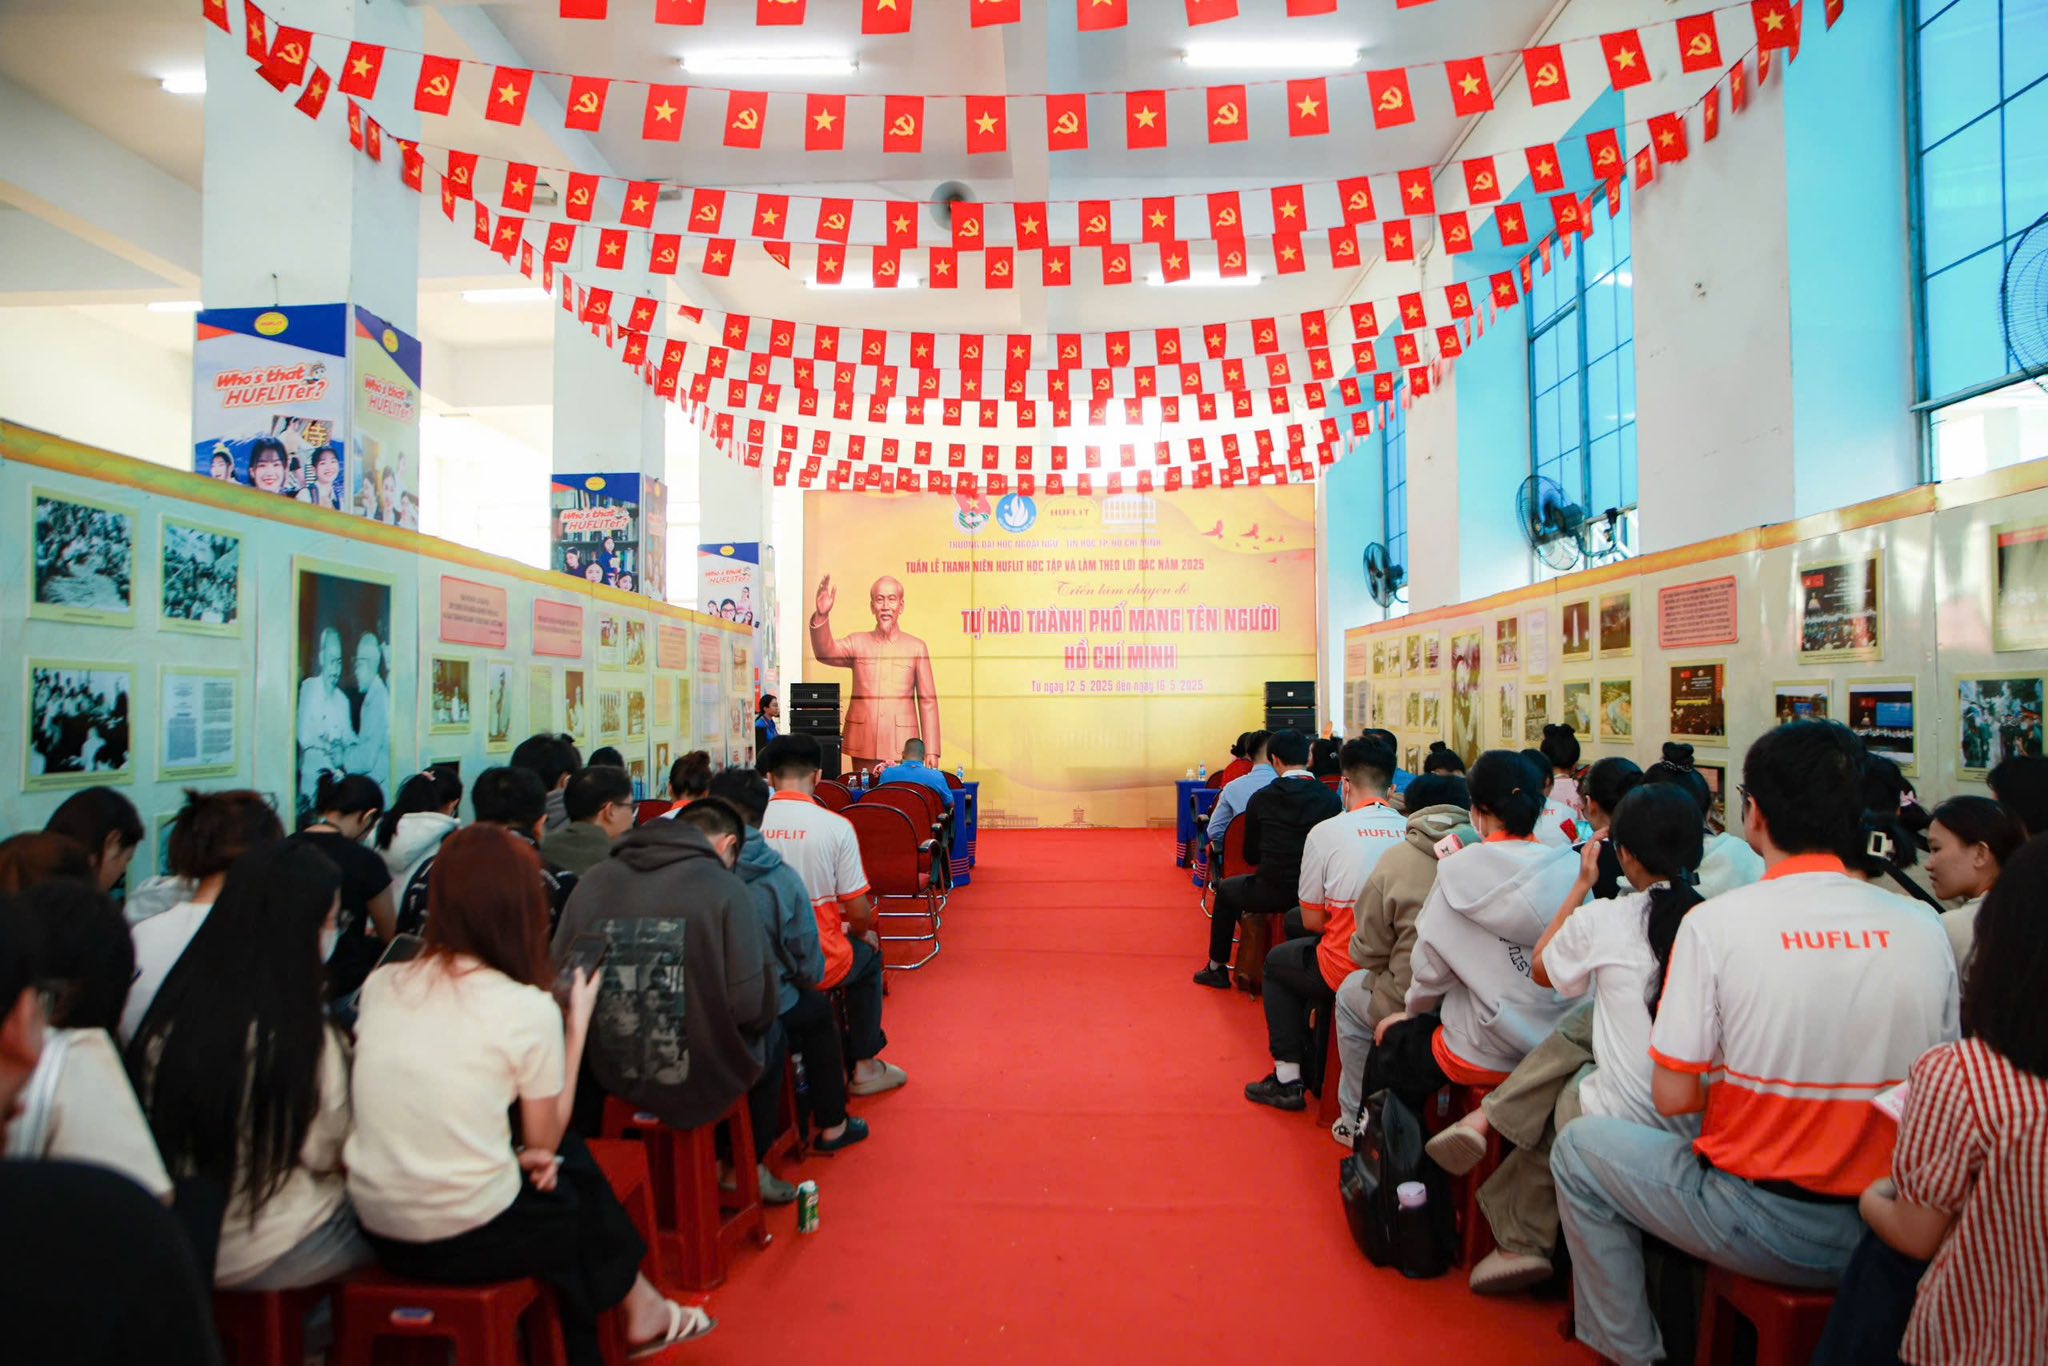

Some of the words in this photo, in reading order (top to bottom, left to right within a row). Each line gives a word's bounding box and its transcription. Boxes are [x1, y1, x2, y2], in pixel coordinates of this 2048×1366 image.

[266, 366, 305, 382] that
[226, 381, 326, 405] HUFLITer?
[592, 508, 615, 519] that
[1050, 508, 1089, 517] HUFLIT
[568, 517, 628, 530] HUFLITer?
[942, 561, 970, 573] THANH
[972, 558, 994, 573] NIÊN
[996, 560, 1024, 573] HUFLIT
[1100, 559, 1120, 572] THEO
[1182, 558, 1205, 571] 2025
[961, 605, 985, 640] TỰ
[988, 604, 1023, 633] HÀO
[1027, 603, 1086, 633] THÀNH
[1089, 600, 1127, 633] PHỐ
[1129, 608, 1184, 633] MANG
[1187, 602, 1220, 633] TÊN
[1224, 602, 1280, 633] NGƯỜI
[1064, 638, 1089, 669] HỒ
[1093, 640, 1124, 669] CHÍ
[1128, 645, 1178, 670] MINH
[762, 830, 806, 840] UFLIT
[1781, 930, 1890, 949] HUFLIT
